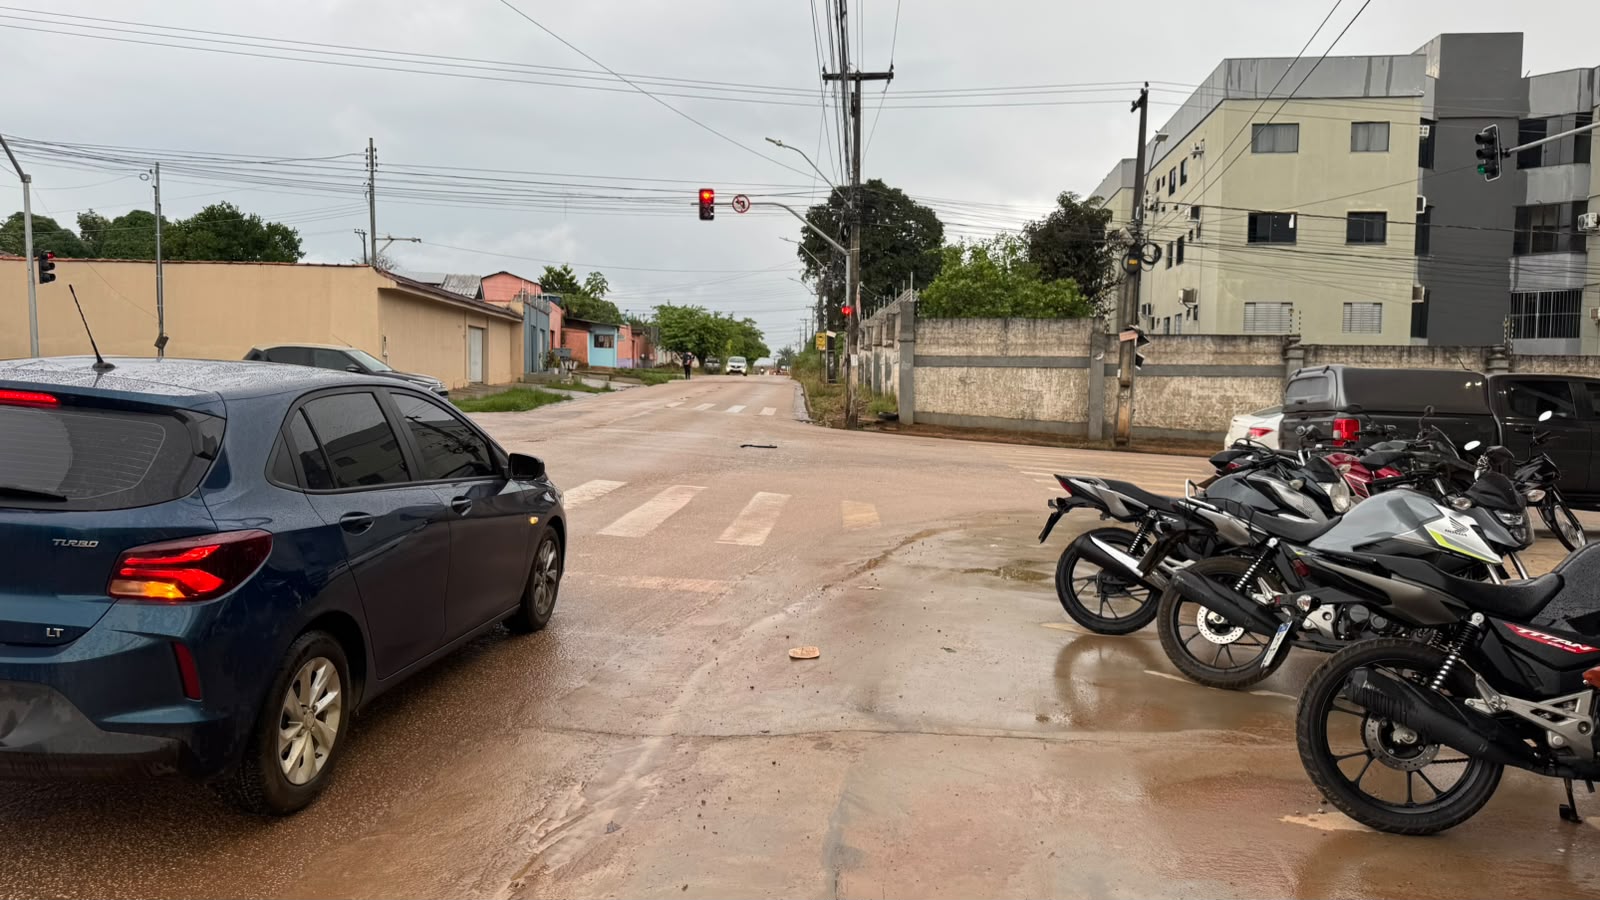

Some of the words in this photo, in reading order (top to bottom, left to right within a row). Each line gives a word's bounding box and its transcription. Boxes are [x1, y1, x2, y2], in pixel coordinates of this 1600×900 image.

[52, 538, 99, 548] TURBO
[46, 627, 64, 638] LT
[1516, 626, 1593, 651] TITAN
